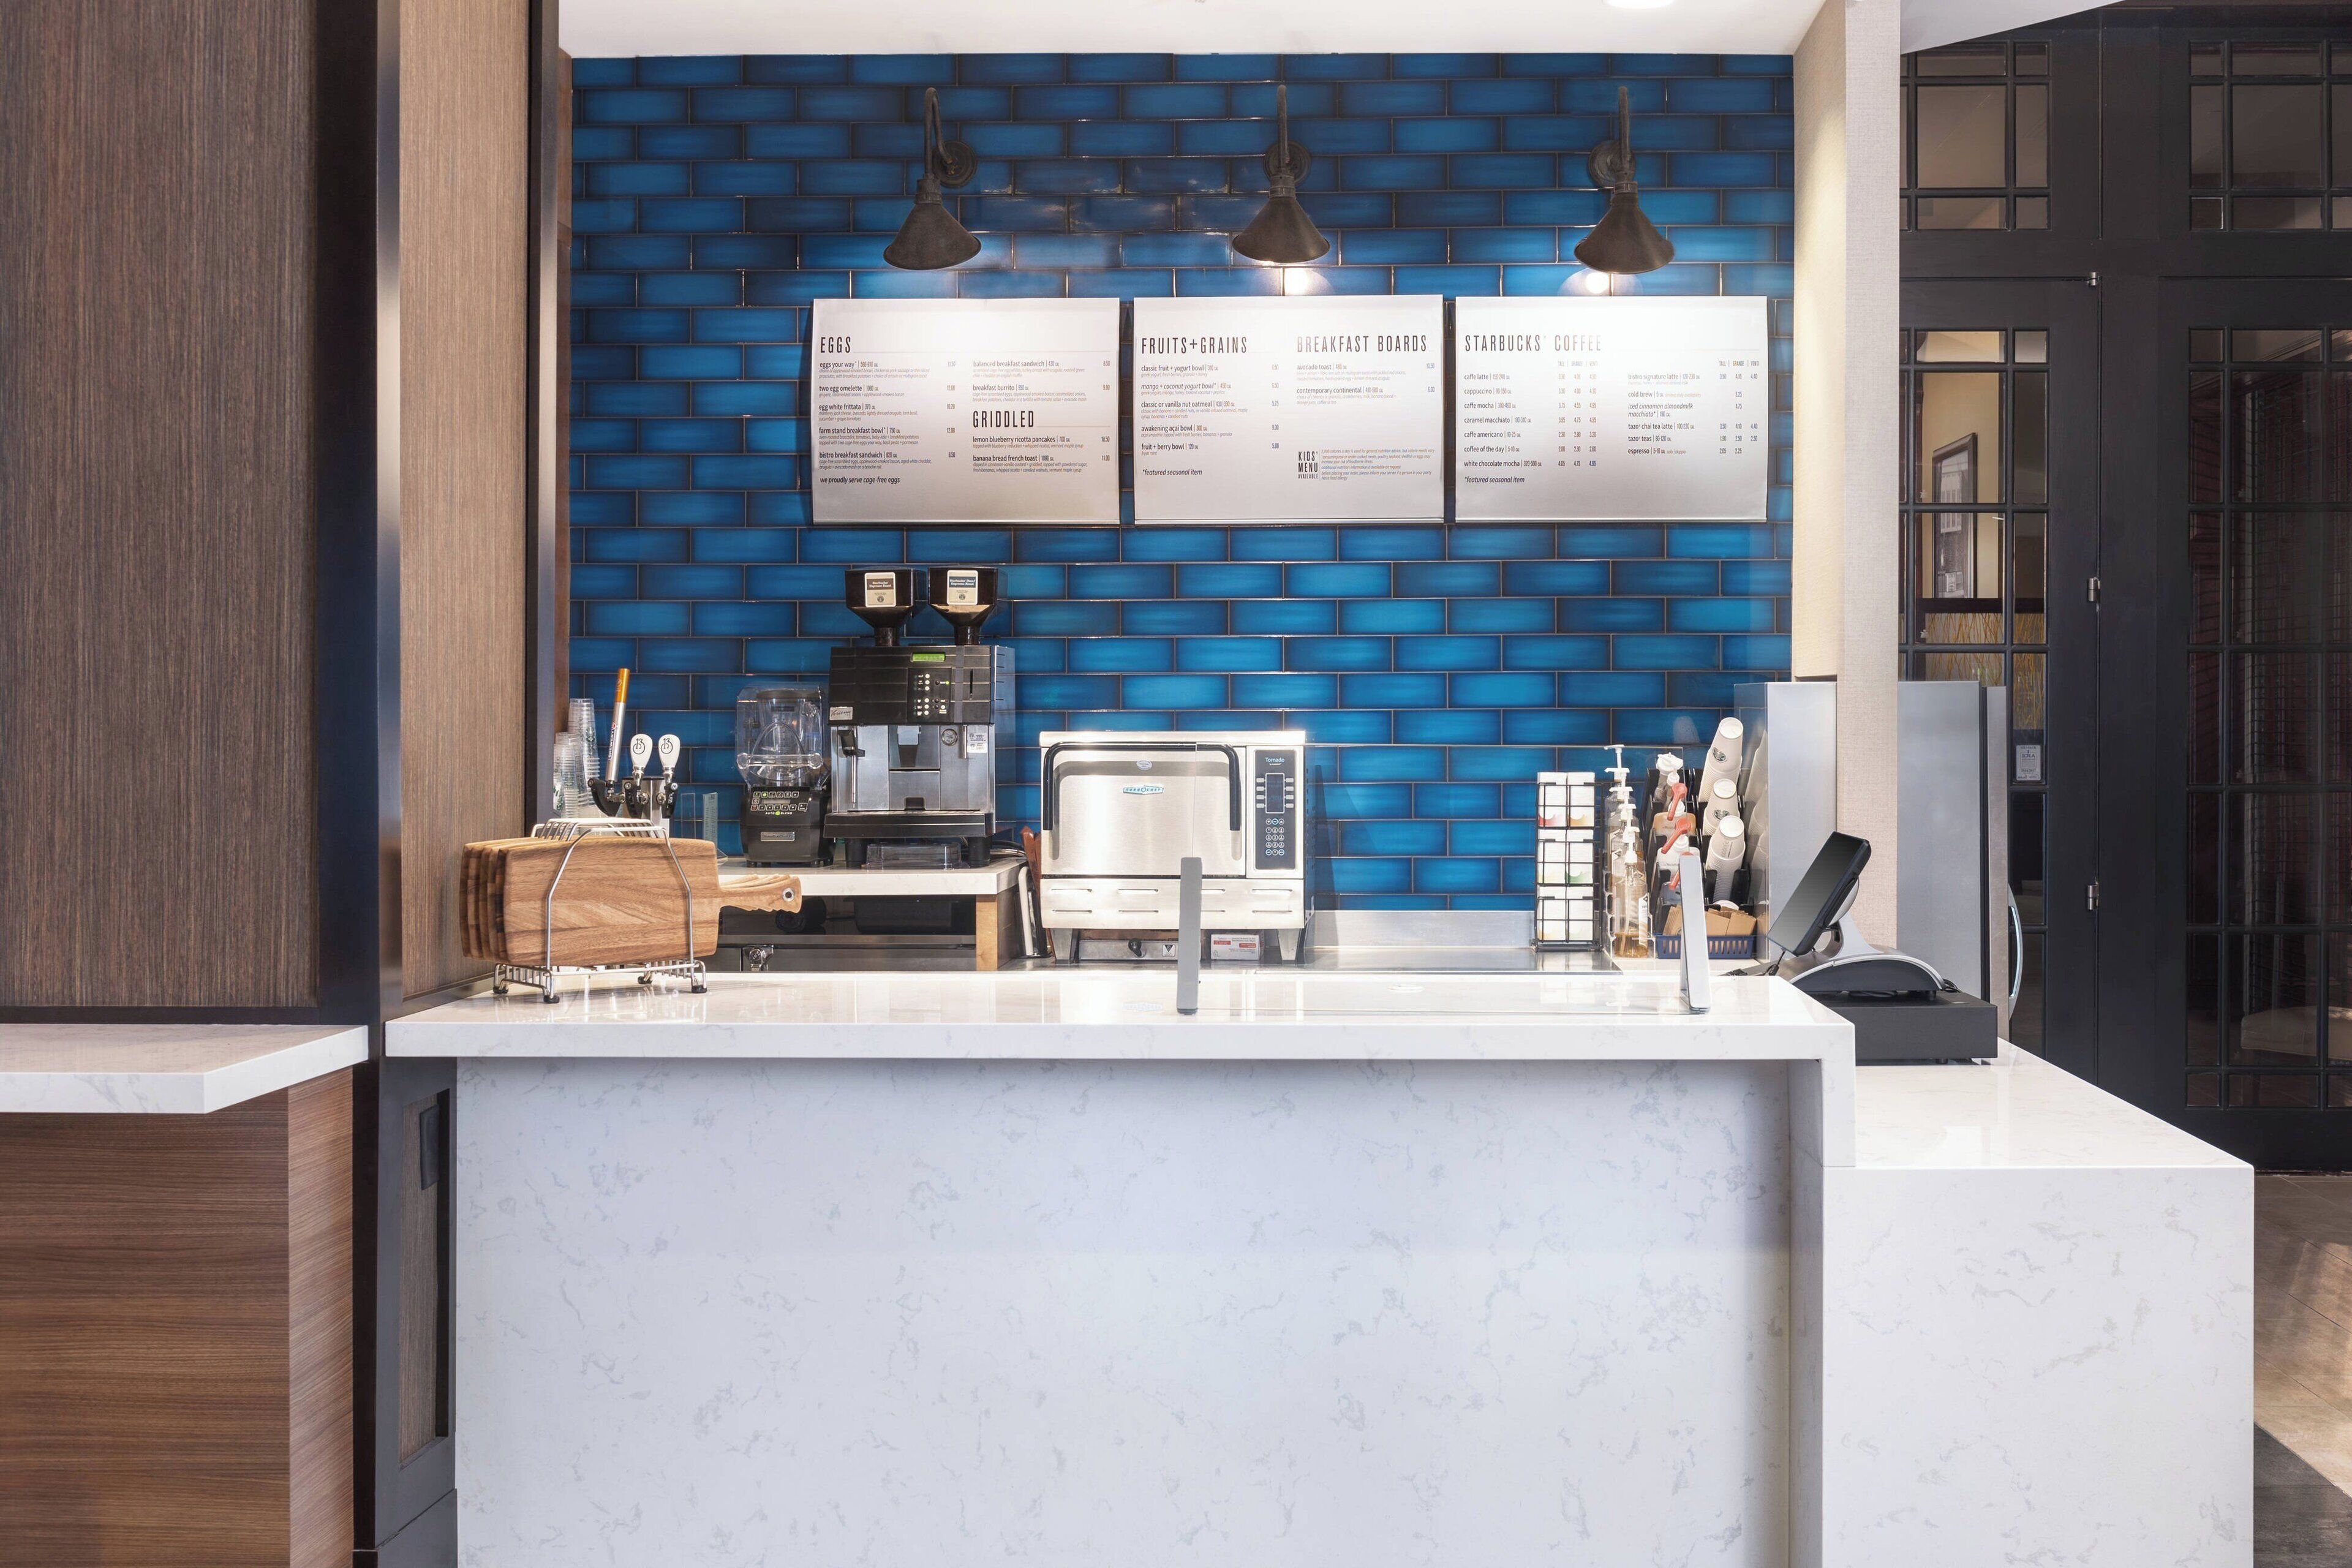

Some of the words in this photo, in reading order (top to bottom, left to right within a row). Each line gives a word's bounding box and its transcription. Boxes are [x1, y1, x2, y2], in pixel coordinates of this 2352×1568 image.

[821, 336, 850, 353] EGGS
[1298, 336, 1369, 352] BREAKFAST
[1378, 335, 1426, 352] BOARDS
[1555, 335, 1600, 351] COFFEE
[973, 410, 1033, 428] GRIDDLED
[1298, 462, 1317, 472] MENU
[827, 476, 848, 484] proudly
[863, 476, 887, 484] cage-free
